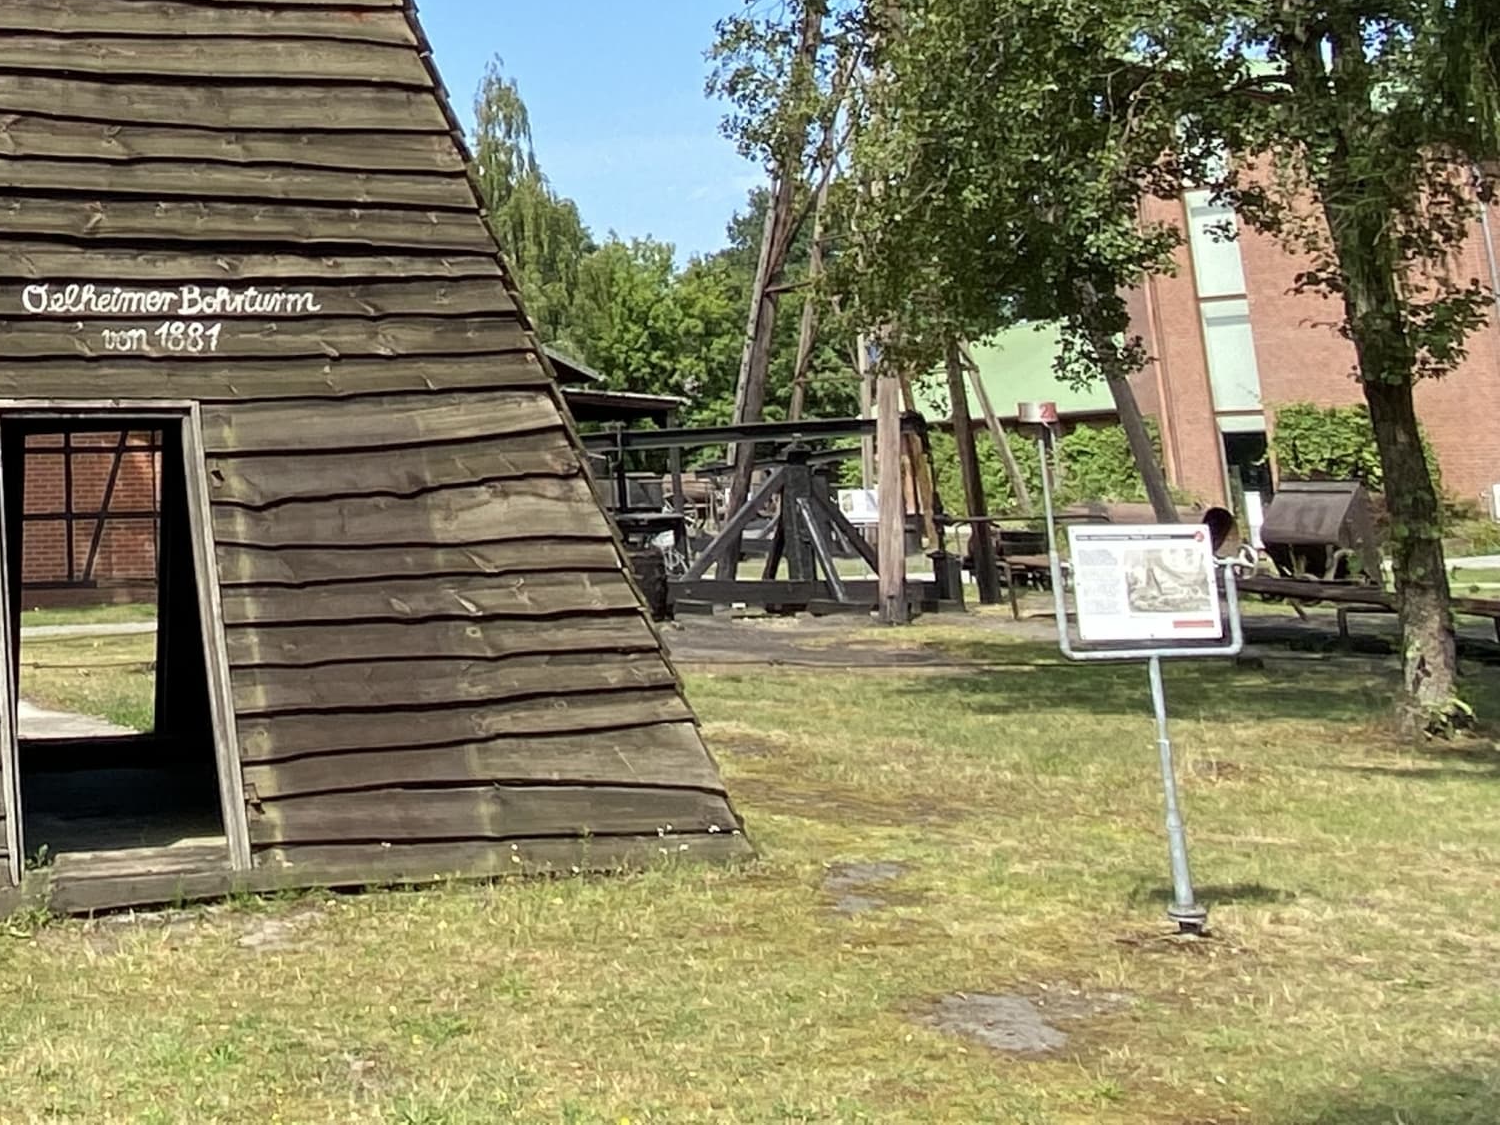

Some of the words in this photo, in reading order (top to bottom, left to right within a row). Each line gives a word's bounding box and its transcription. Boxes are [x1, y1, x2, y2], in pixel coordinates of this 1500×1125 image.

[22, 283, 179, 313] Oelheimer
[177, 284, 322, 315] Bohrturm
[101, 328, 151, 352] von
[154, 321, 222, 353] 1881
